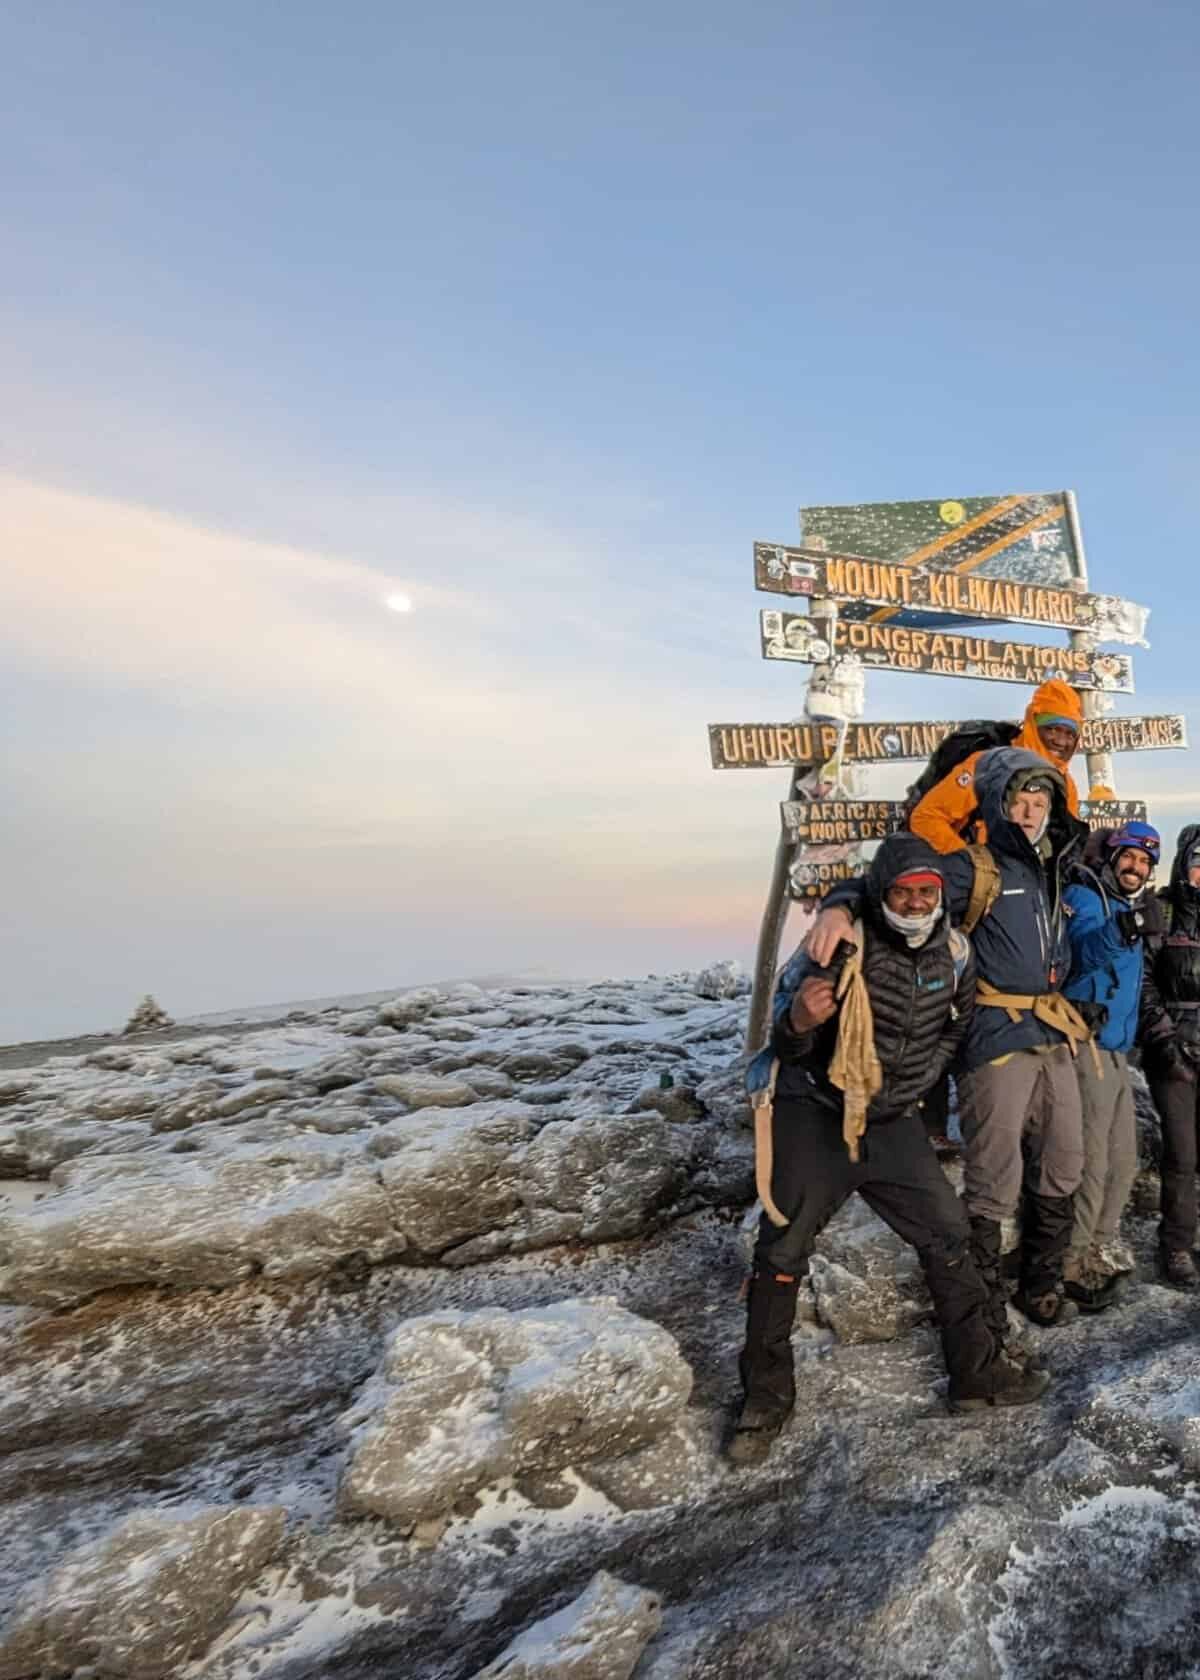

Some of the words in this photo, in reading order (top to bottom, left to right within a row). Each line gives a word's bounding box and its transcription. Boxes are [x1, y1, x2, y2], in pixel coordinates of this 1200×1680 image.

[825, 557, 912, 604] MOUNT
[931, 573, 1075, 622] KILIMANJARO
[827, 619, 1089, 671] CONGRATULATIONS
[888, 652, 921, 668] YOU
[931, 657, 965, 673] ARE
[976, 663, 1016, 678] NOW
[1025, 666, 1043, 681] AT
[721, 726, 813, 762] UHURU
[820, 725, 886, 759] PEAK
[810, 822, 886, 842] WORLD'S
